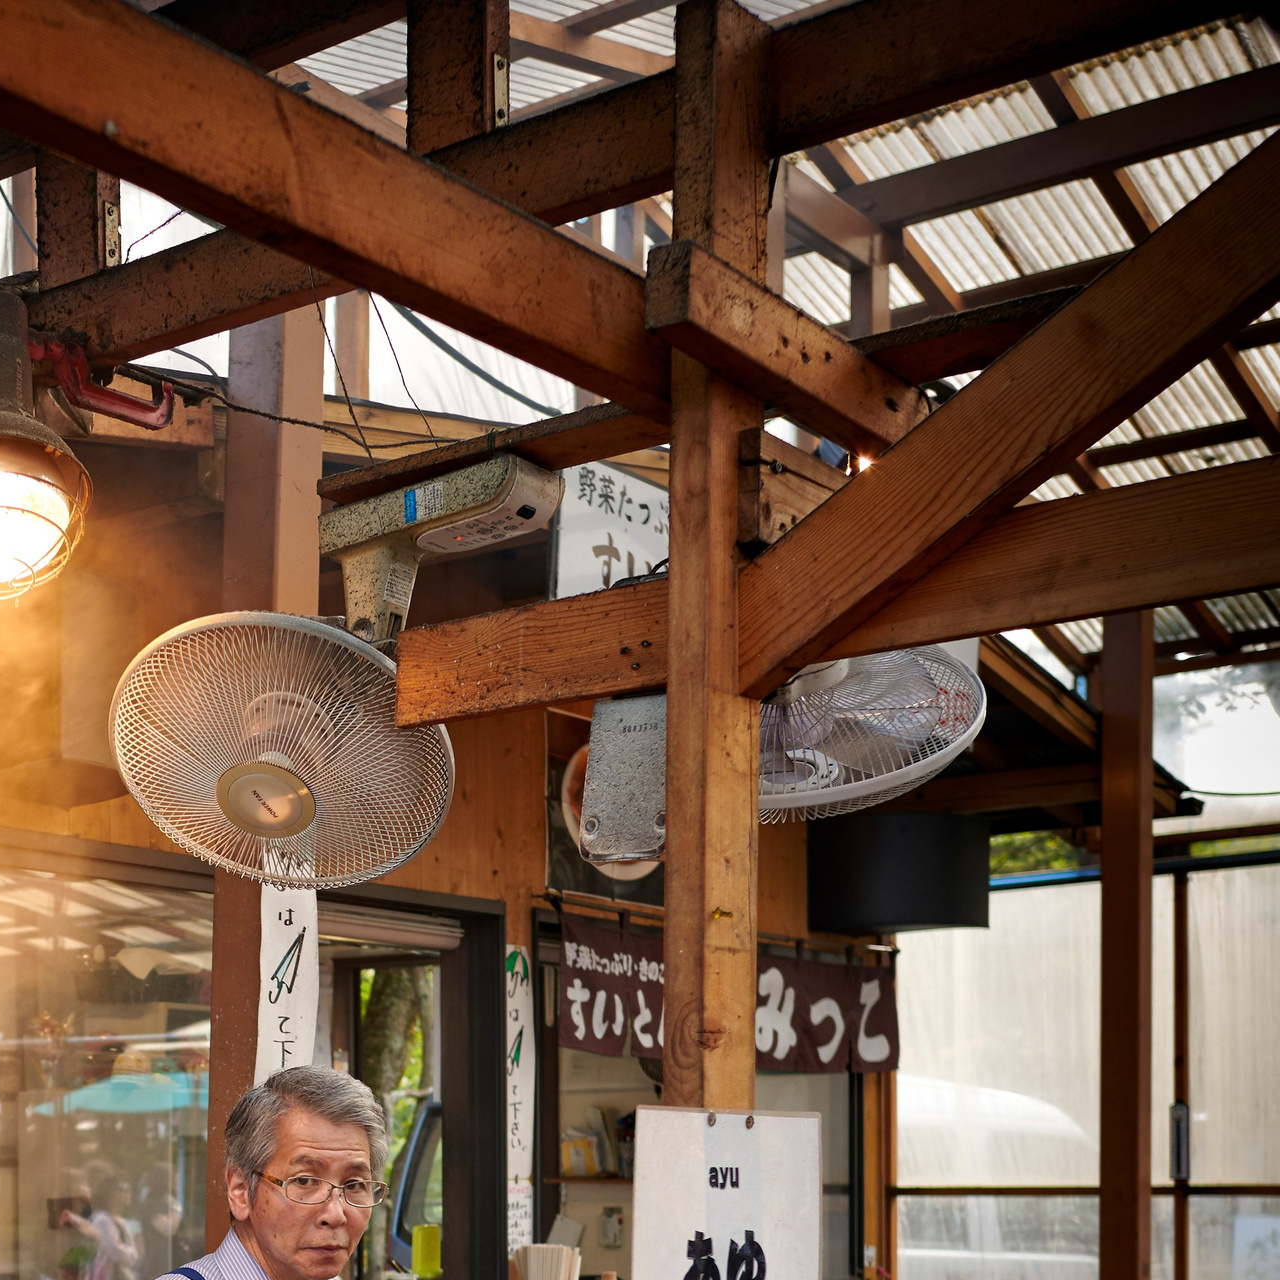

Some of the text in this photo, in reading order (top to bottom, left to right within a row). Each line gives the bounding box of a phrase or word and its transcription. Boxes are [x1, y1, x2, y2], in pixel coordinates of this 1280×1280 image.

[592, 532, 669, 589] すい
[251, 790, 279, 818] POWER FAN
[278, 908, 295, 926] は
[566, 978, 664, 1049] すいと
[708, 1166, 740, 1190] ayu
